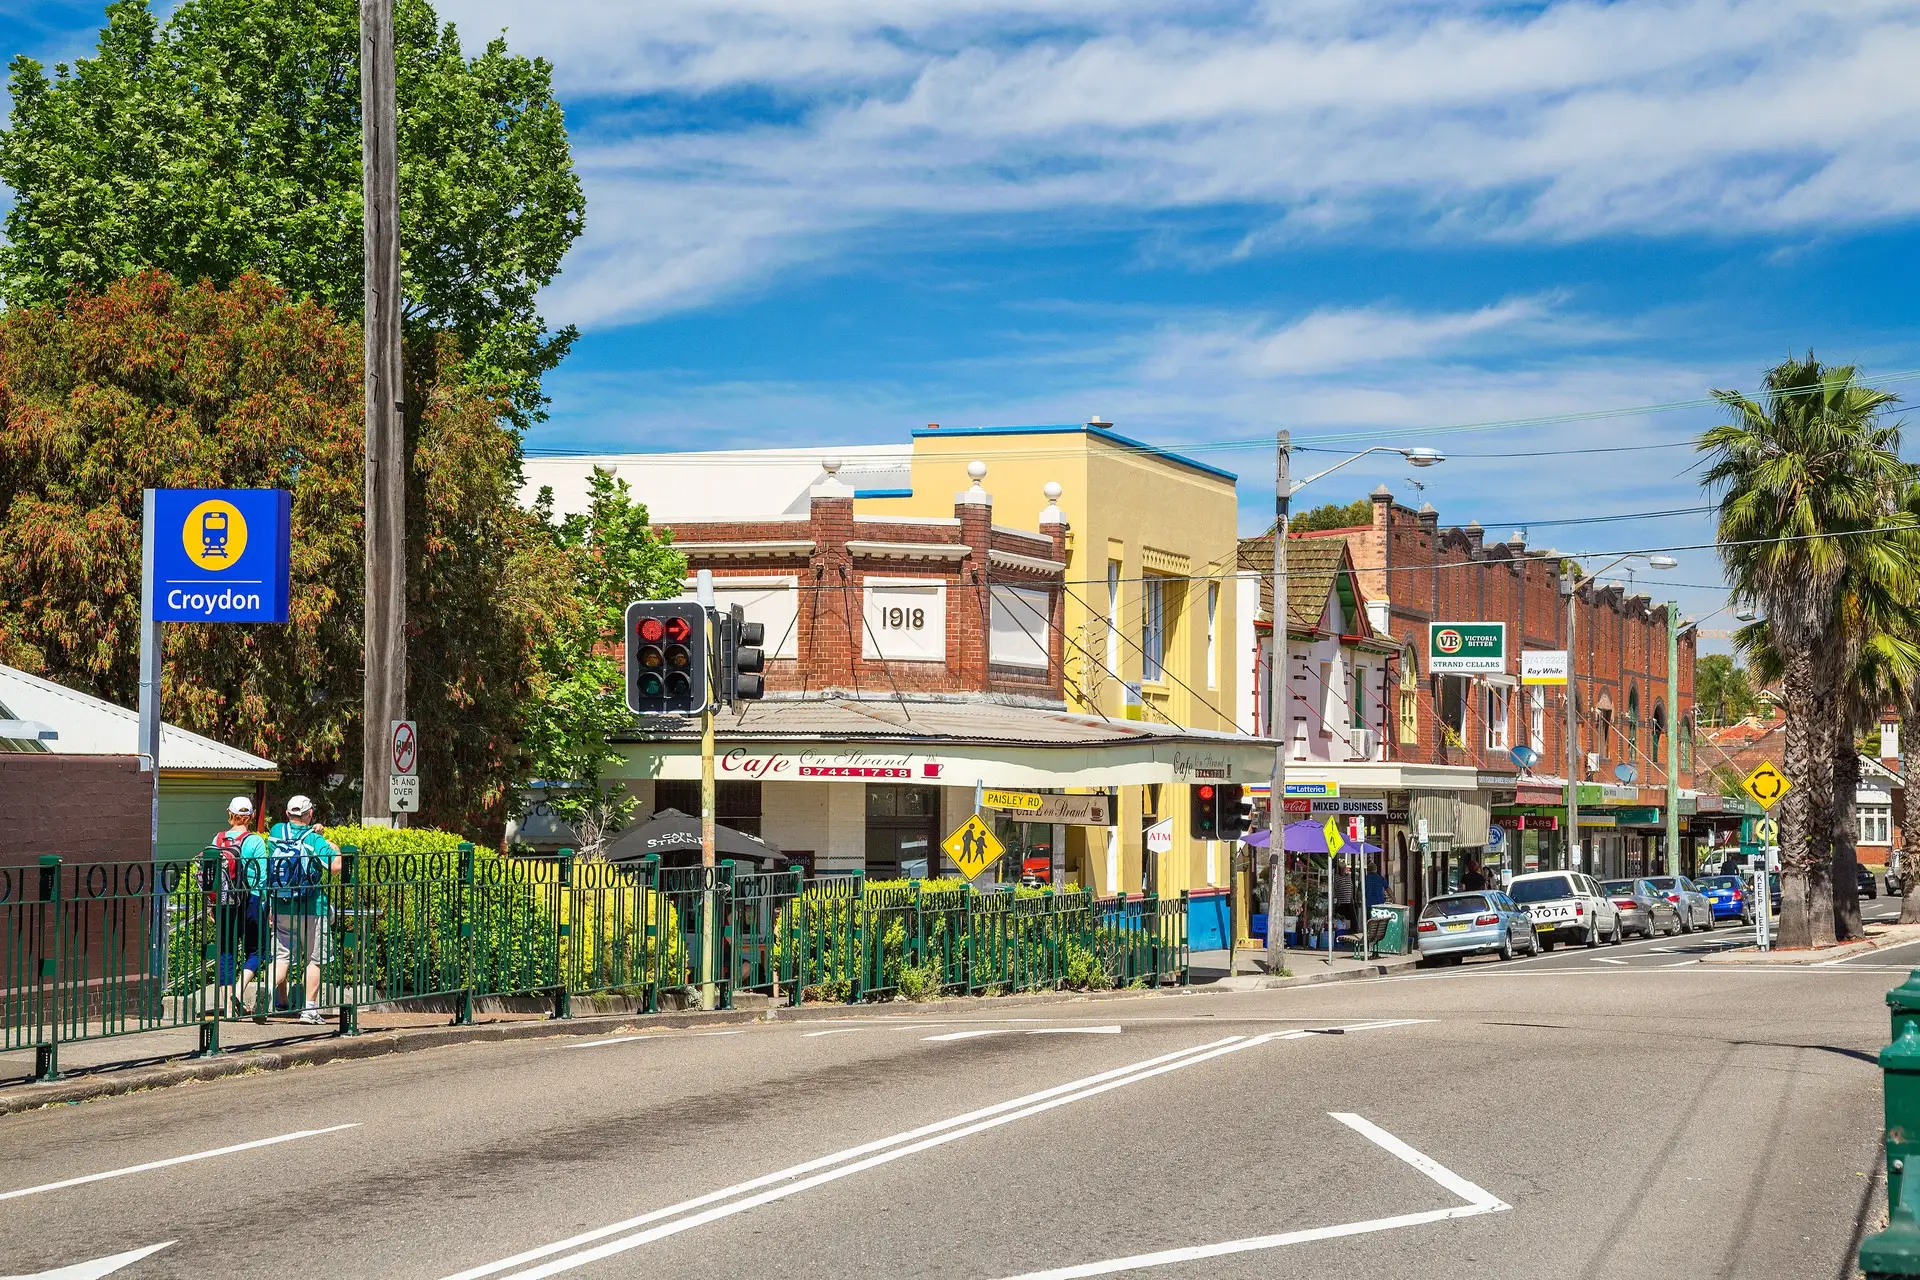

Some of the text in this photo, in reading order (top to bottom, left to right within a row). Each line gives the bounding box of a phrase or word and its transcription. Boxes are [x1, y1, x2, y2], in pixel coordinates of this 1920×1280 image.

[167, 588, 260, 615] Croydon
[882, 607, 924, 629] 1918
[1440, 635, 1459, 647] VB
[721, 747, 914, 779] Cafe On Strand
[1173, 751, 1193, 781] Cafe
[802, 767, 909, 778] 9744 1738
[391, 778, 416, 786] 3t AND
[393, 788, 413, 796] OVER
[1296, 785, 1325, 793] Lotteries
[988, 793, 1040, 807] PAISLEY RD
[1055, 798, 1089, 818] Strand
[1312, 802, 1383, 812] MIXED BUSINESS
[1385, 812, 1408, 820] TOKY
[661, 831, 693, 839] CAFE
[1148, 832, 1171, 841] ATM
[1529, 908, 1568, 919] OYOTA
